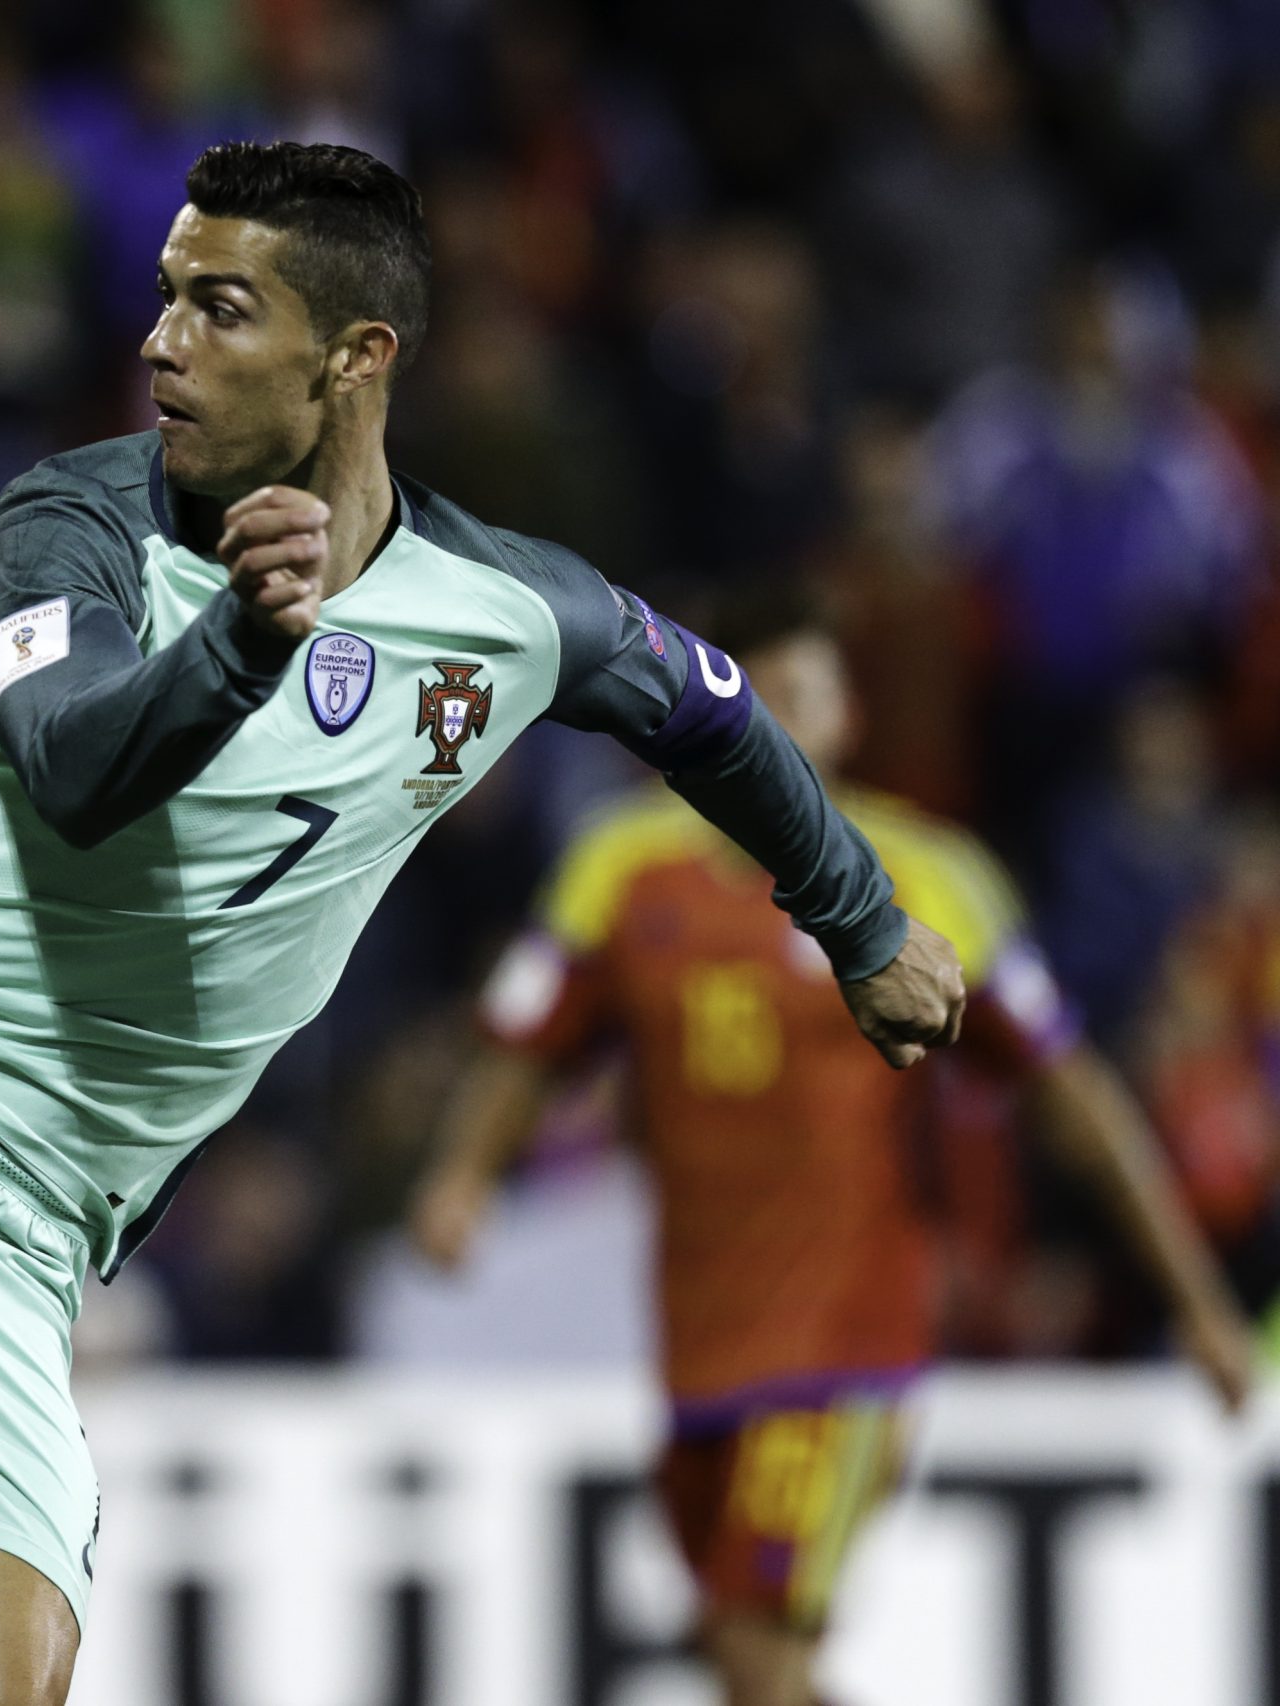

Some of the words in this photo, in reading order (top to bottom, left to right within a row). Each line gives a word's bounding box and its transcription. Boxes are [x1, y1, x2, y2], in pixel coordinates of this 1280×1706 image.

[330, 641, 356, 653] UEFA
[315, 653, 367, 667] EUROPEAN
[314, 662, 366, 676] CHAMPIONS
[216, 794, 339, 911] 7
